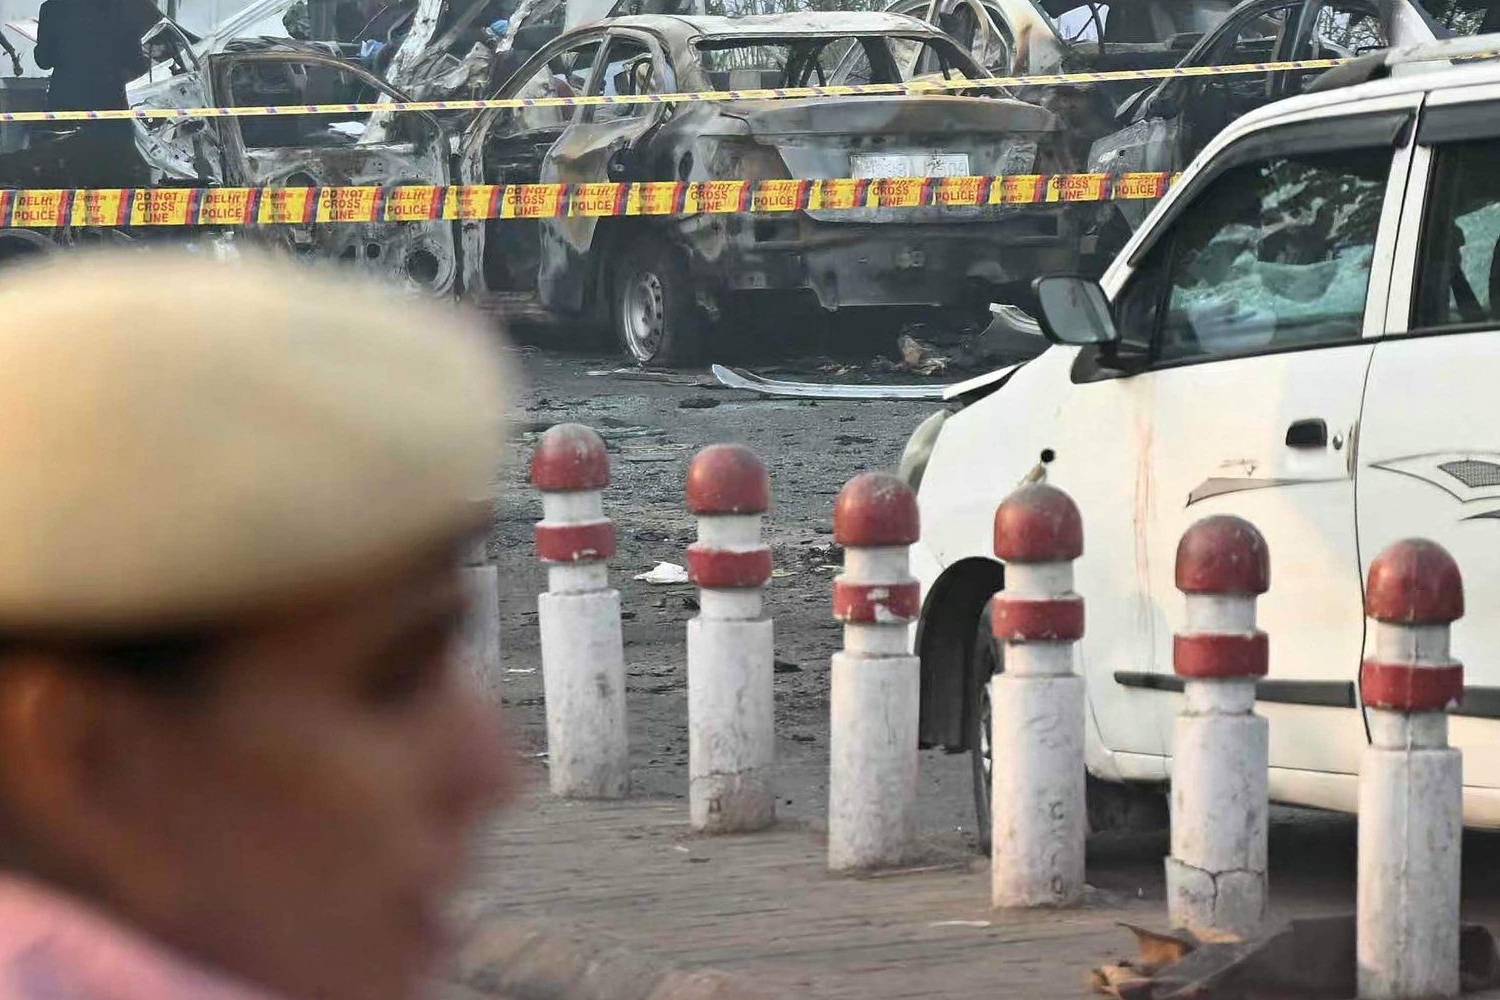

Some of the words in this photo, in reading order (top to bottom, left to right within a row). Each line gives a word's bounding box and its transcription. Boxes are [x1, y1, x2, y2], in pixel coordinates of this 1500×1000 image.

[1052, 180, 1089, 189] CROSS
[322, 190, 338, 198] DO
[340, 190, 363, 198] NOT
[872, 187, 909, 195] CROSS
[1114, 185, 1154, 195] POLICE
[136, 192, 152, 201] DO
[154, 192, 178, 201] NOT
[507, 195, 545, 204] CROSS
[690, 191, 728, 200] CROSS
[936, 192, 974, 200] POLICE
[19, 197, 53, 206] DELHI
[323, 200, 361, 209] CROSS
[571, 201, 612, 210] POLICE
[754, 197, 794, 206] POLICE
[137, 203, 175, 211] CROSS
[388, 206, 428, 215] POLICE
[514, 206, 539, 215] LINE
[14, 211, 55, 220] POLICE
[202, 209, 242, 218] POLICE
[329, 211, 354, 219] LINE
[143, 214, 169, 223] LINE
